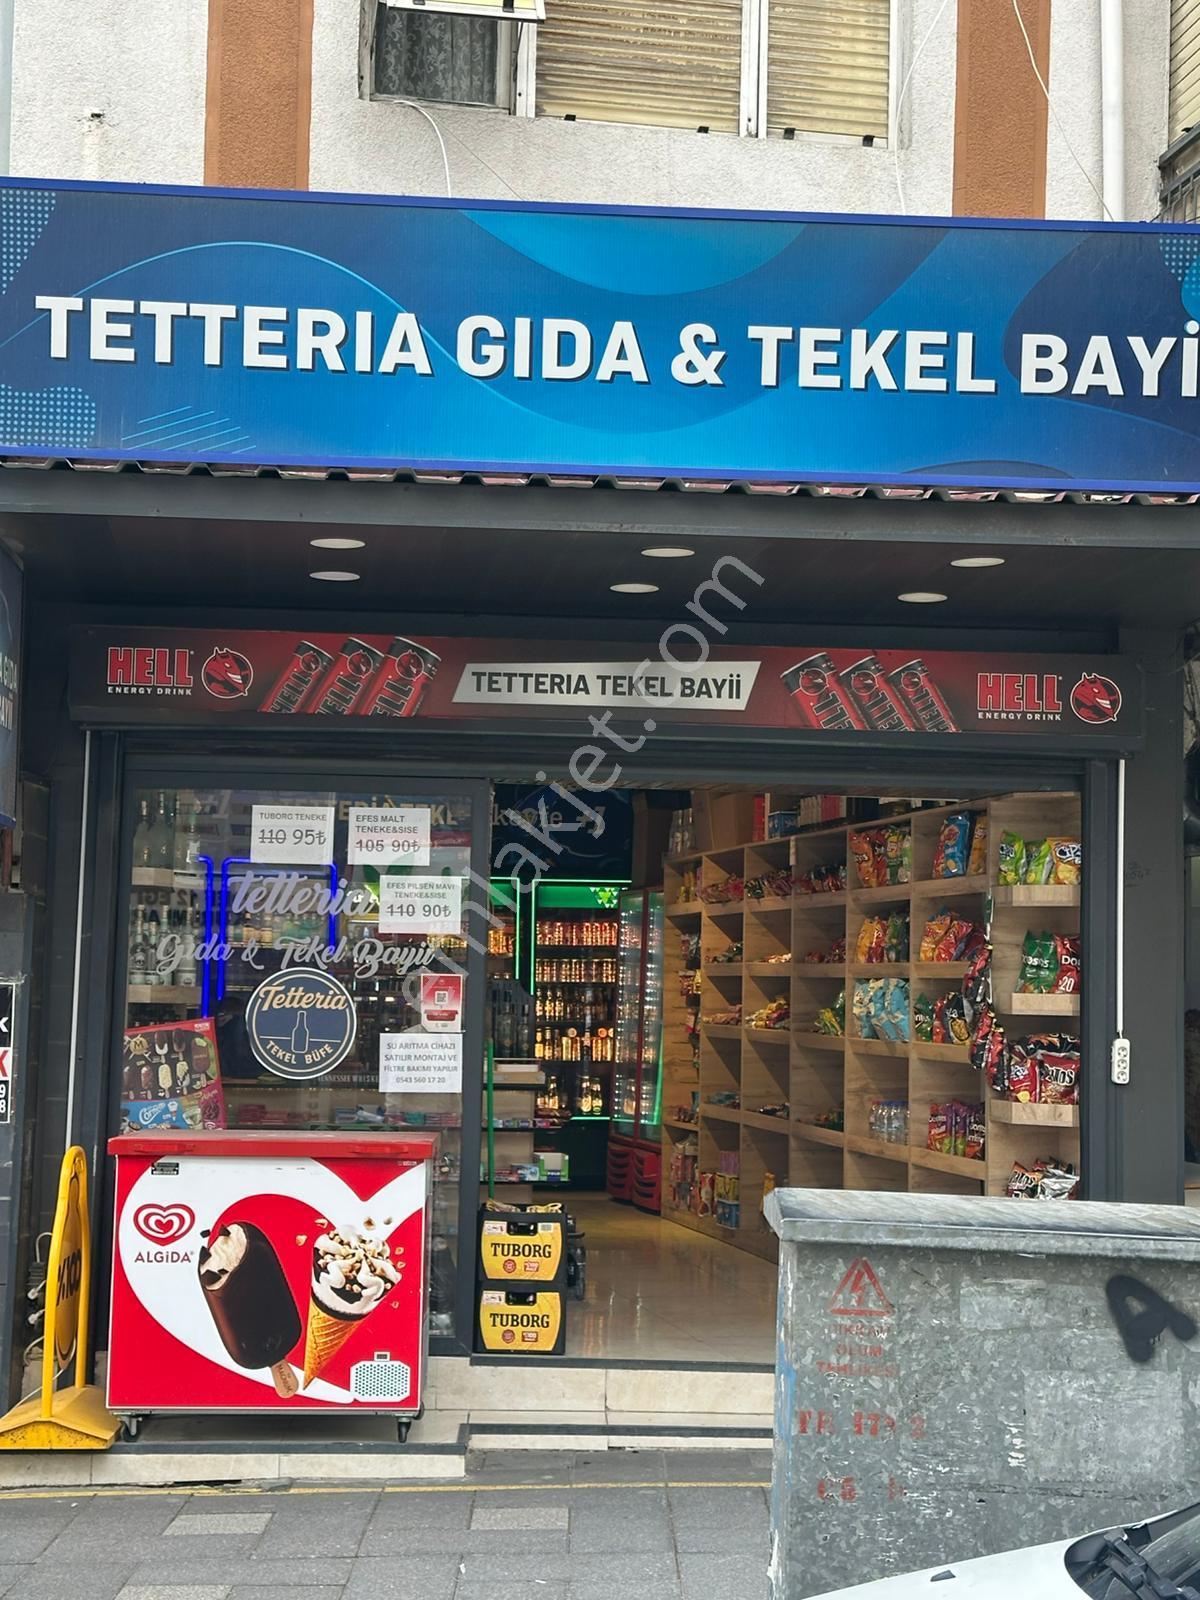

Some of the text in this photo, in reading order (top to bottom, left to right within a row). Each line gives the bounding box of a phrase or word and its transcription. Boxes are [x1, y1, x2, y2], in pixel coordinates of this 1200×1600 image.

[36, 296, 433, 376] TETTERIA
[457, 315, 649, 383] GIDA
[671, 324, 728, 386] &
[748, 326, 996, 393] TEKEL
[107, 647, 193, 687] HELL
[107, 686, 192, 696] ENERGY DRINK
[471, 671, 590, 695] TETTERIA
[596, 674, 673, 698] TEKEL
[977, 672, 1063, 712] HELL
[978, 711, 1062, 721] ENERGY DRINK
[259, 812, 327, 822] TUBORG TENEKE
[355, 814, 405, 824] EFES MALT
[258, 828, 287, 845] 110
[355, 839, 385, 853] 105
[227, 870, 377, 916] tetteria
[386, 882, 406, 890] EFES
[407, 882, 435, 890] PILSEN
[386, 904, 416, 917] 110
[273, 935, 346, 970] Tekel
[259, 984, 348, 1011] Tetteria
[265, 1040, 334, 1064] TEKEL BÜFE
[491, 1242, 551, 1258] TUBORG
[490, 1312, 550, 1328] TUBORG
